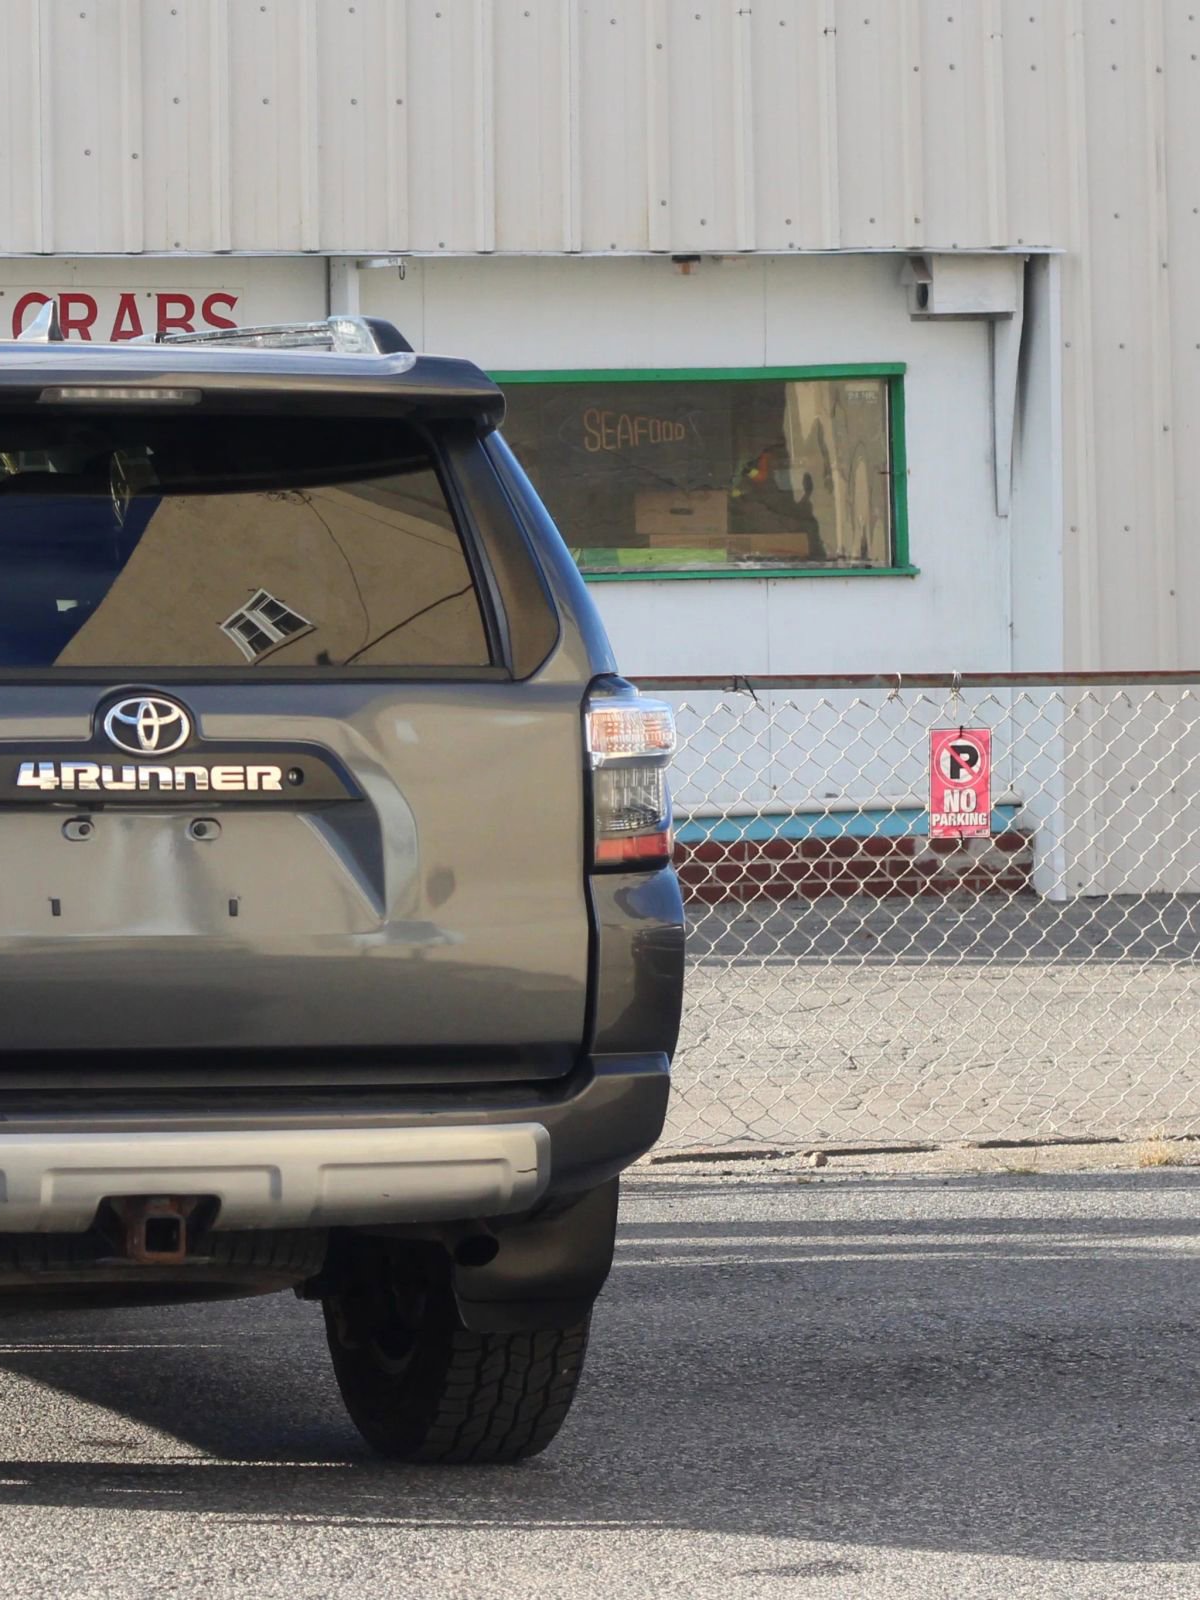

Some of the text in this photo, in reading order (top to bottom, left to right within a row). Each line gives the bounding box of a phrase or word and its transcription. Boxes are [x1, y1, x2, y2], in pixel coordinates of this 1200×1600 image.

[11, 291, 239, 342] CRABS
[583, 408, 686, 452] SEAFOOD
[943, 788, 977, 813] NO
[931, 812, 988, 827] PARKING
